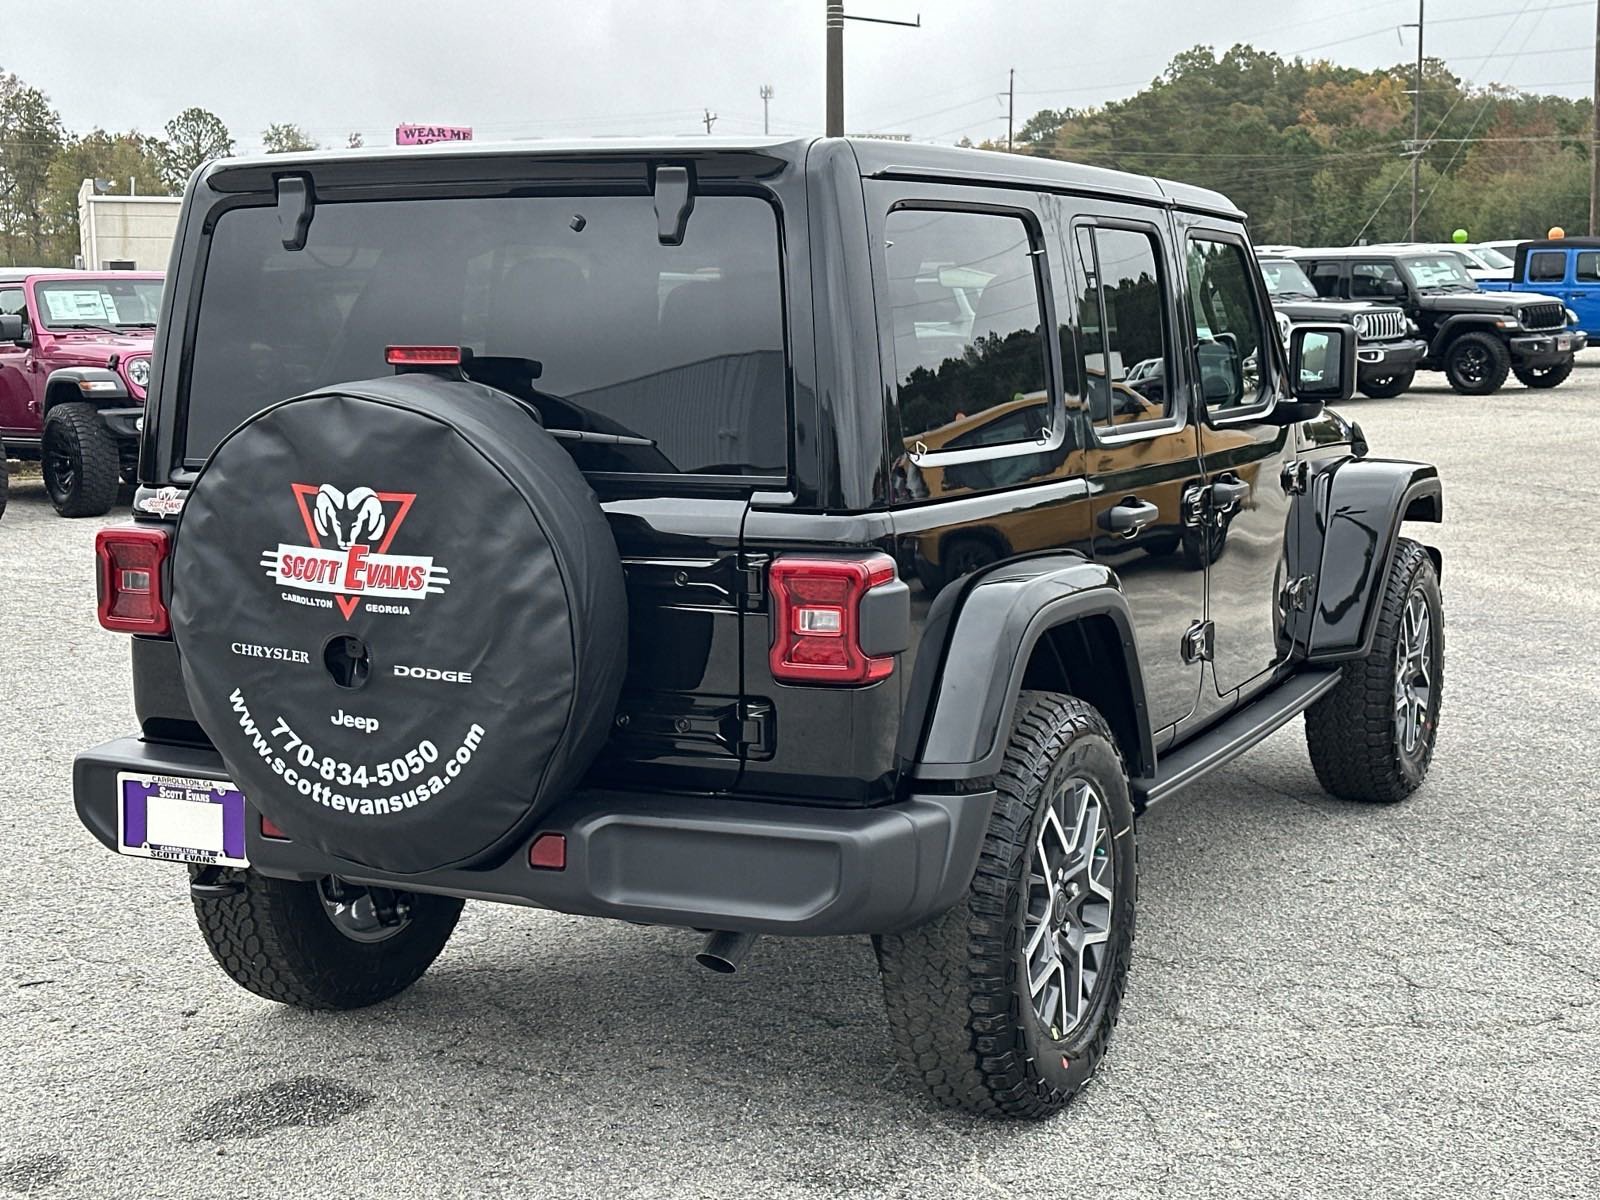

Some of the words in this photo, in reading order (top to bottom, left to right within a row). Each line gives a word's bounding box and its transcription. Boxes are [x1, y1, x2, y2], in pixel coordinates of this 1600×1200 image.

[404, 127, 447, 139] WEAR
[280, 554, 342, 585] SCOTT
[344, 544, 428, 591] EVANS
[281, 592, 333, 609] CARROLLTON
[365, 603, 411, 616] GEORGIA
[231, 642, 310, 664] CHRYSLER
[393, 664, 473, 684] DODGE
[330, 709, 379, 734] Jeep
[228, 687, 486, 816] www.scottevansusa.com
[270, 716, 440, 788] 770-834-5050
[150, 850, 180, 860] SCOTT
[184, 854, 217, 864] EVANS
